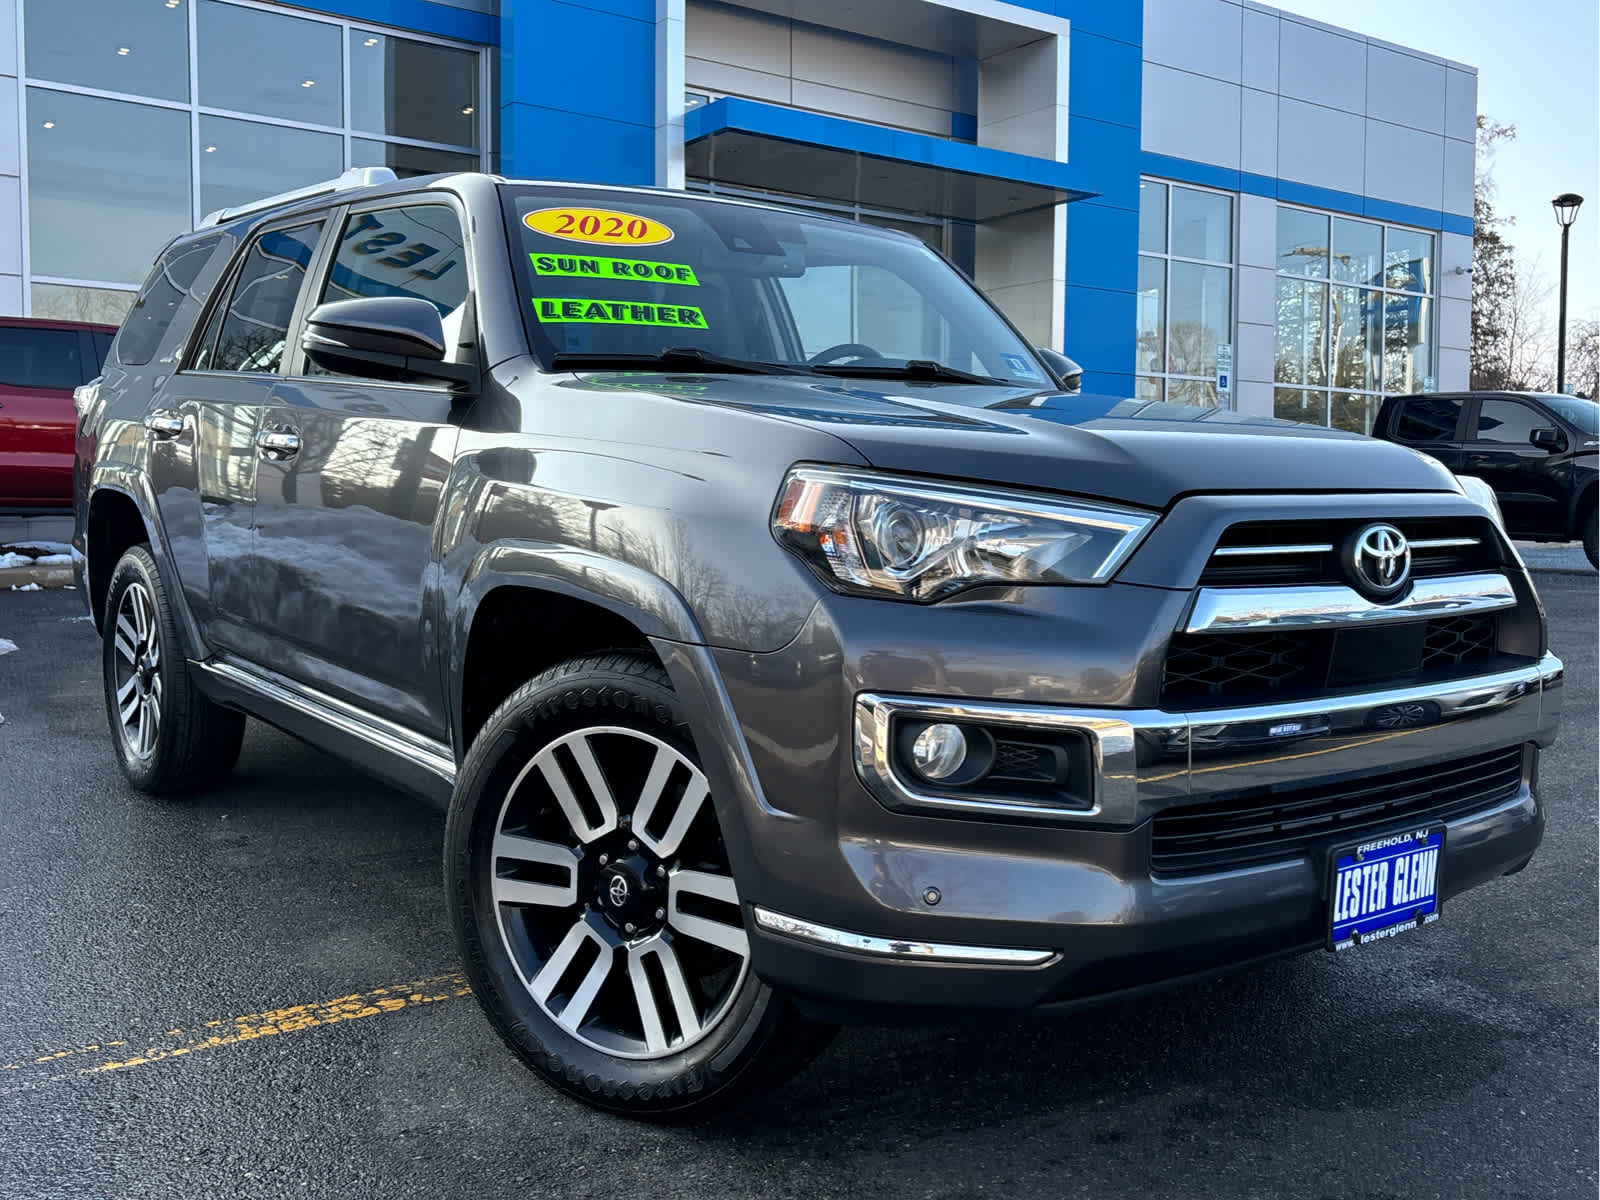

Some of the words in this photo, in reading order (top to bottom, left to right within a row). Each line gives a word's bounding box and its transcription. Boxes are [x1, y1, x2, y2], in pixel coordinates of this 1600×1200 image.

[554, 214, 648, 239] 2020
[537, 256, 600, 274] SUN
[612, 261, 692, 281] ROOF
[540, 301, 702, 326] LEATHER
[1356, 833, 1413, 855] FREEHOLD,
[1415, 829, 1429, 840] NJ
[1333, 861, 1389, 923] LESTER
[1392, 848, 1438, 906] GLENN
